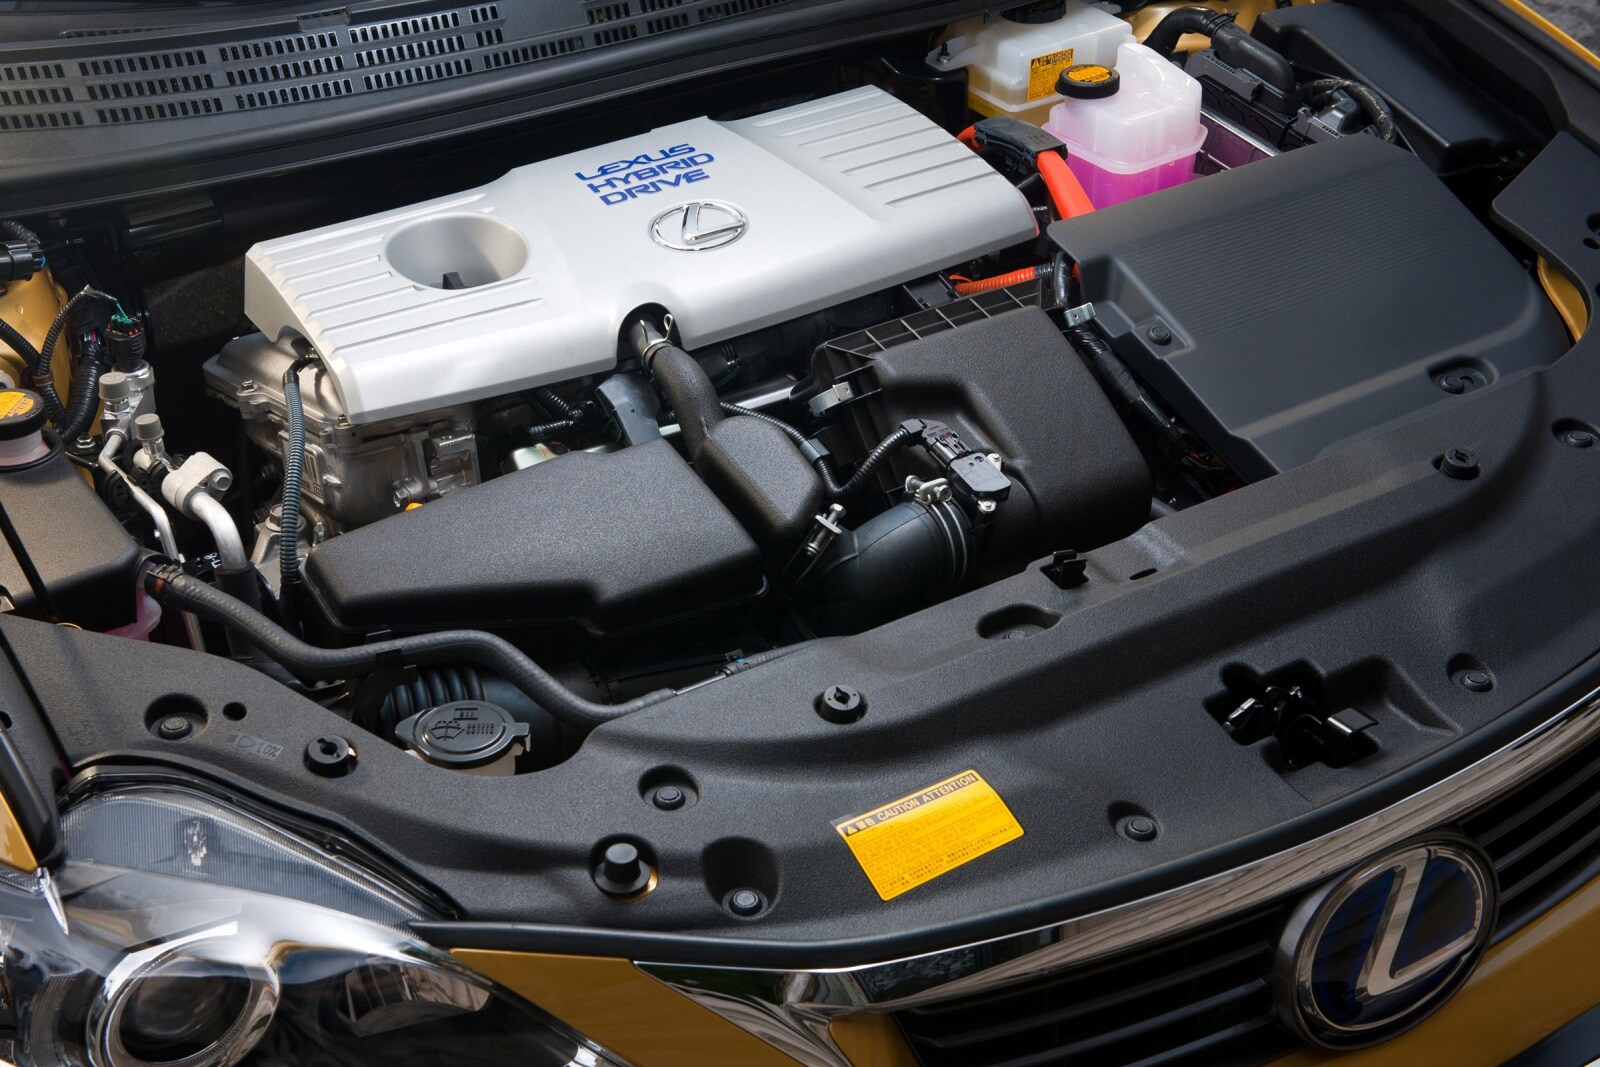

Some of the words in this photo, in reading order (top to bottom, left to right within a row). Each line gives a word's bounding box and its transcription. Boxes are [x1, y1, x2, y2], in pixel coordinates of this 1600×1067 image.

[575, 143, 696, 181] LEXUS
[587, 153, 715, 193] HYBRID
[599, 168, 711, 206] DRIVE
[876, 798, 920, 821] CAUTION
[922, 774, 977, 803] ATTENTION
